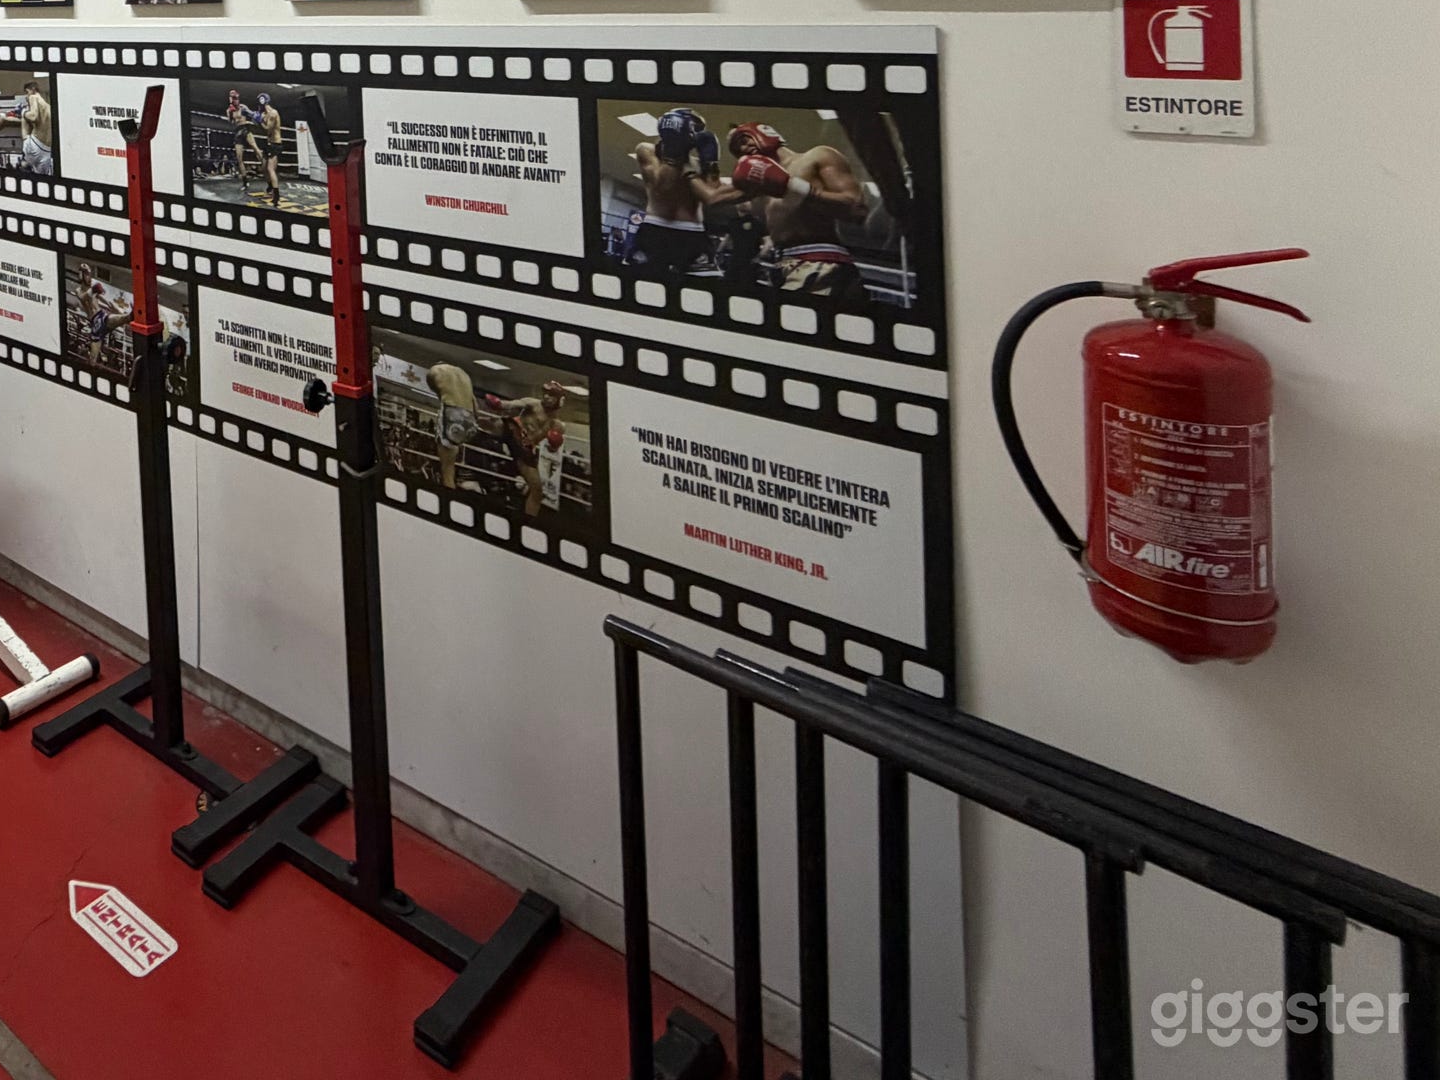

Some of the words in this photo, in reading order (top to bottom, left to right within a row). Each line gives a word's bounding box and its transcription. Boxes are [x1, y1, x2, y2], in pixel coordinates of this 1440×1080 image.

[108, 107, 125, 117] PERDO
[1125, 97, 1243, 116] ESTINTORE
[90, 118, 93, 127] O
[401, 123, 447, 138] SUCCESSO
[450, 126, 469, 139] NON
[472, 125, 476, 140] È
[480, 128, 536, 147] DEFINITIVO,
[539, 133, 547, 146] IL
[388, 138, 439, 154] FALLIMENTO
[442, 143, 460, 156] NON
[464, 142, 468, 156] È
[471, 146, 505, 160] FATALE:
[508, 147, 525, 161] CIÒ
[528, 151, 547, 164] CHE
[375, 152, 402, 166] CONTA
[404, 153, 409, 167] È
[411, 156, 418, 168] IL
[421, 157, 467, 173] CORAGGIO
[470, 162, 479, 174] DI
[482, 164, 521, 179] ANDARE
[524, 167, 566, 183] AVANTI”
[425, 195, 461, 209] WINSTON
[463, 199, 508, 215] CHURCHILL
[215, 332, 225, 344] DEI
[227, 335, 264, 355] FALLIMENTI.
[266, 344, 272, 357] IL
[274, 347, 292, 363] VERO
[294, 353, 337, 375] FALLIMENTO
[231, 322, 266, 340] SCONFITTA
[268, 331, 282, 345] NON
[284, 333, 288, 345] È
[289, 337, 295, 349] IL
[297, 339, 333, 358] PEGGIORE
[234, 349, 237, 362] È
[239, 352, 252, 365] NON
[254, 357, 278, 373] AVERCI
[232, 382, 254, 397] GEORGE
[255, 389, 280, 405] EDWARD
[1119, 408, 1228, 436] ESTINTORE
[631, 426, 663, 448] “NON
[666, 435, 687, 454] HAI
[691, 441, 748, 470] BISOGNO
[752, 456, 766, 475] DI
[770, 462, 822, 489] VEDERE
[826, 476, 890, 508] L’INTERA
[642, 448, 712, 480] SCALINATA.
[716, 468, 754, 493] INIZIA
[758, 480, 877, 526] SEMPLICEMENTE
[662, 473, 670, 488] A
[674, 477, 716, 501] SALIRE
[720, 490, 730, 506] IL
[734, 494, 778, 520] PRIMO
[782, 508, 852, 539] SCALINO”
[684, 523, 726, 548] MARTIN
[730, 537, 771, 562] LUTHER
[775, 551, 807, 575] KING,
[810, 562, 828, 580] JR.
